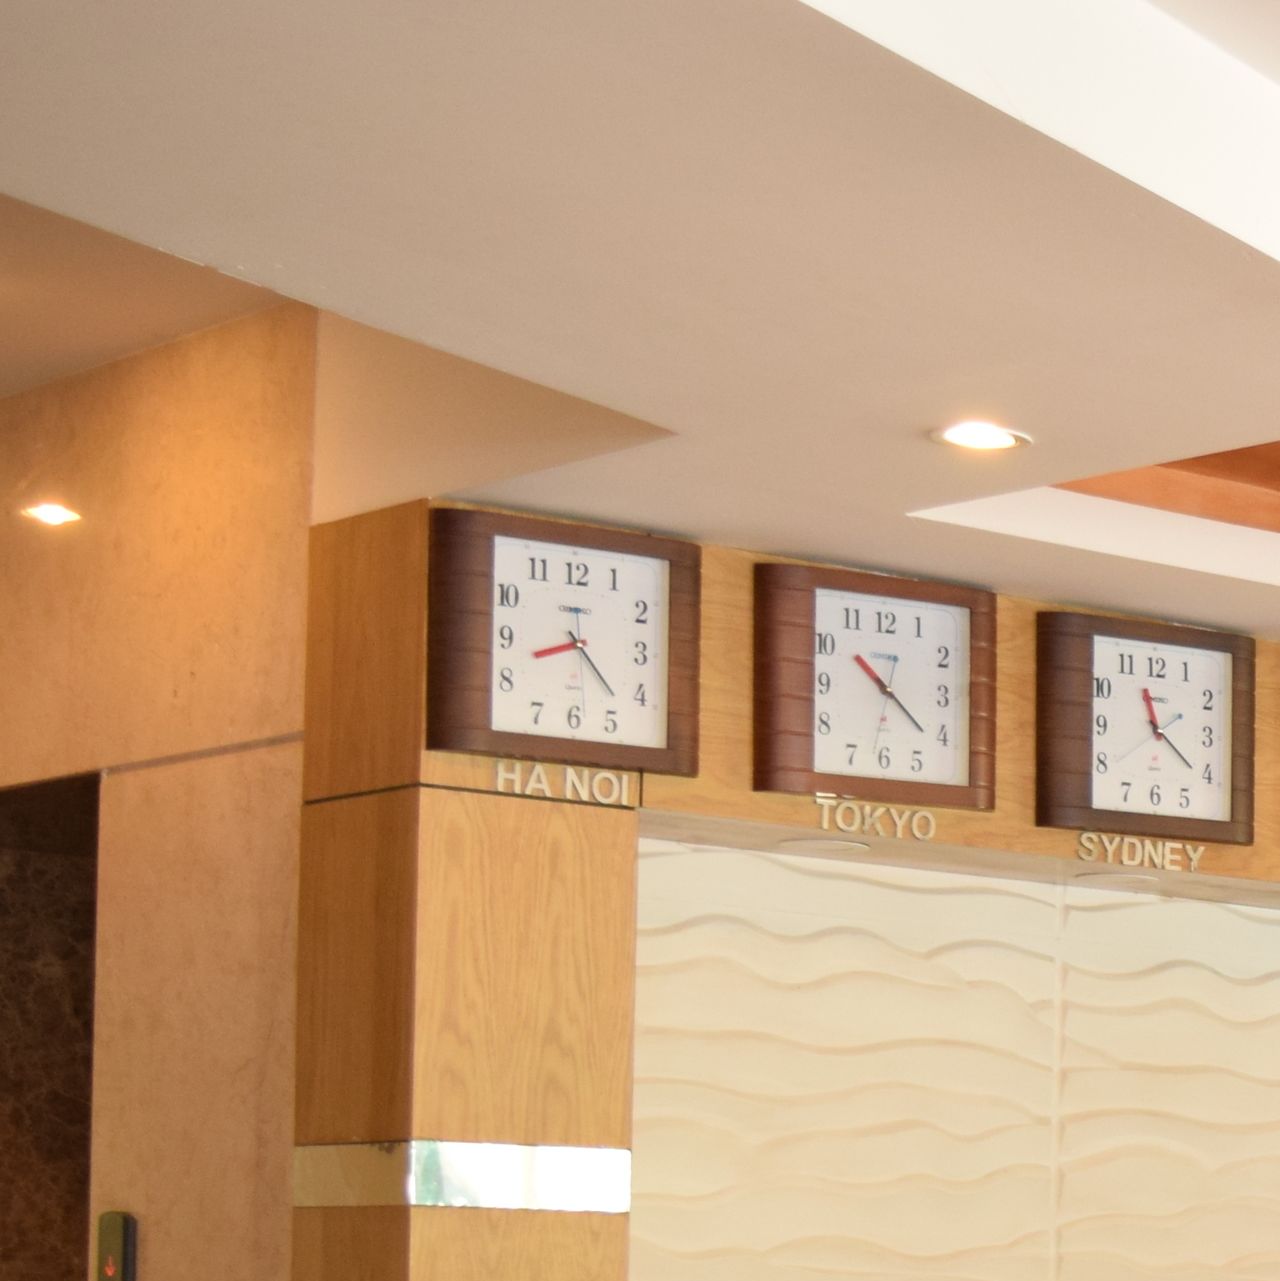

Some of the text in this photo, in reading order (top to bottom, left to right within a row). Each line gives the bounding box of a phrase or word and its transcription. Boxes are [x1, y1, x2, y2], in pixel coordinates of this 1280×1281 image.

[529, 558, 549, 581] 11
[565, 563, 589, 586] 12
[610, 568, 619, 591] 1
[498, 584, 519, 608] 10
[635, 600, 648, 623] 2
[843, 608, 862, 631] 11
[875, 611, 896, 634] 12
[500, 625, 513, 649] 9
[915, 616, 923, 638] 1
[634, 641, 647, 665] 3
[816, 633, 835, 656] 10
[938, 646, 949, 668] 2
[1119, 653, 1135, 675] 11
[1147, 657, 1166, 678] 12
[499, 668, 513, 692] 8
[1182, 662, 1189, 681] 1
[634, 683, 646, 706] 4
[818, 672, 830, 695] 9
[1094, 677, 1111, 699] 10
[937, 685, 949, 708] 3
[1203, 689, 1213, 711] 2
[531, 702, 544, 725] 7
[567, 705, 580, 729] 6
[604, 710, 617, 733] 5
[818, 712, 831, 735] 8
[937, 724, 949, 746] 4
[1096, 715, 1107, 736] 9
[1202, 726, 1213, 748] 3
[846, 744, 857, 765] 7
[878, 747, 890, 769] 6
[911, 751, 922, 772] 5
[1096, 752, 1107, 774] 8
[497, 761, 628, 805] HA NOI
[1202, 763, 1212, 784] 4
[1121, 782, 1131, 802] 7
[1150, 785, 1161, 806] 6
[1179, 789, 1190, 808] 5
[816, 797, 936, 840] TOKYO
[1078, 832, 1205, 871] SYDNEY
